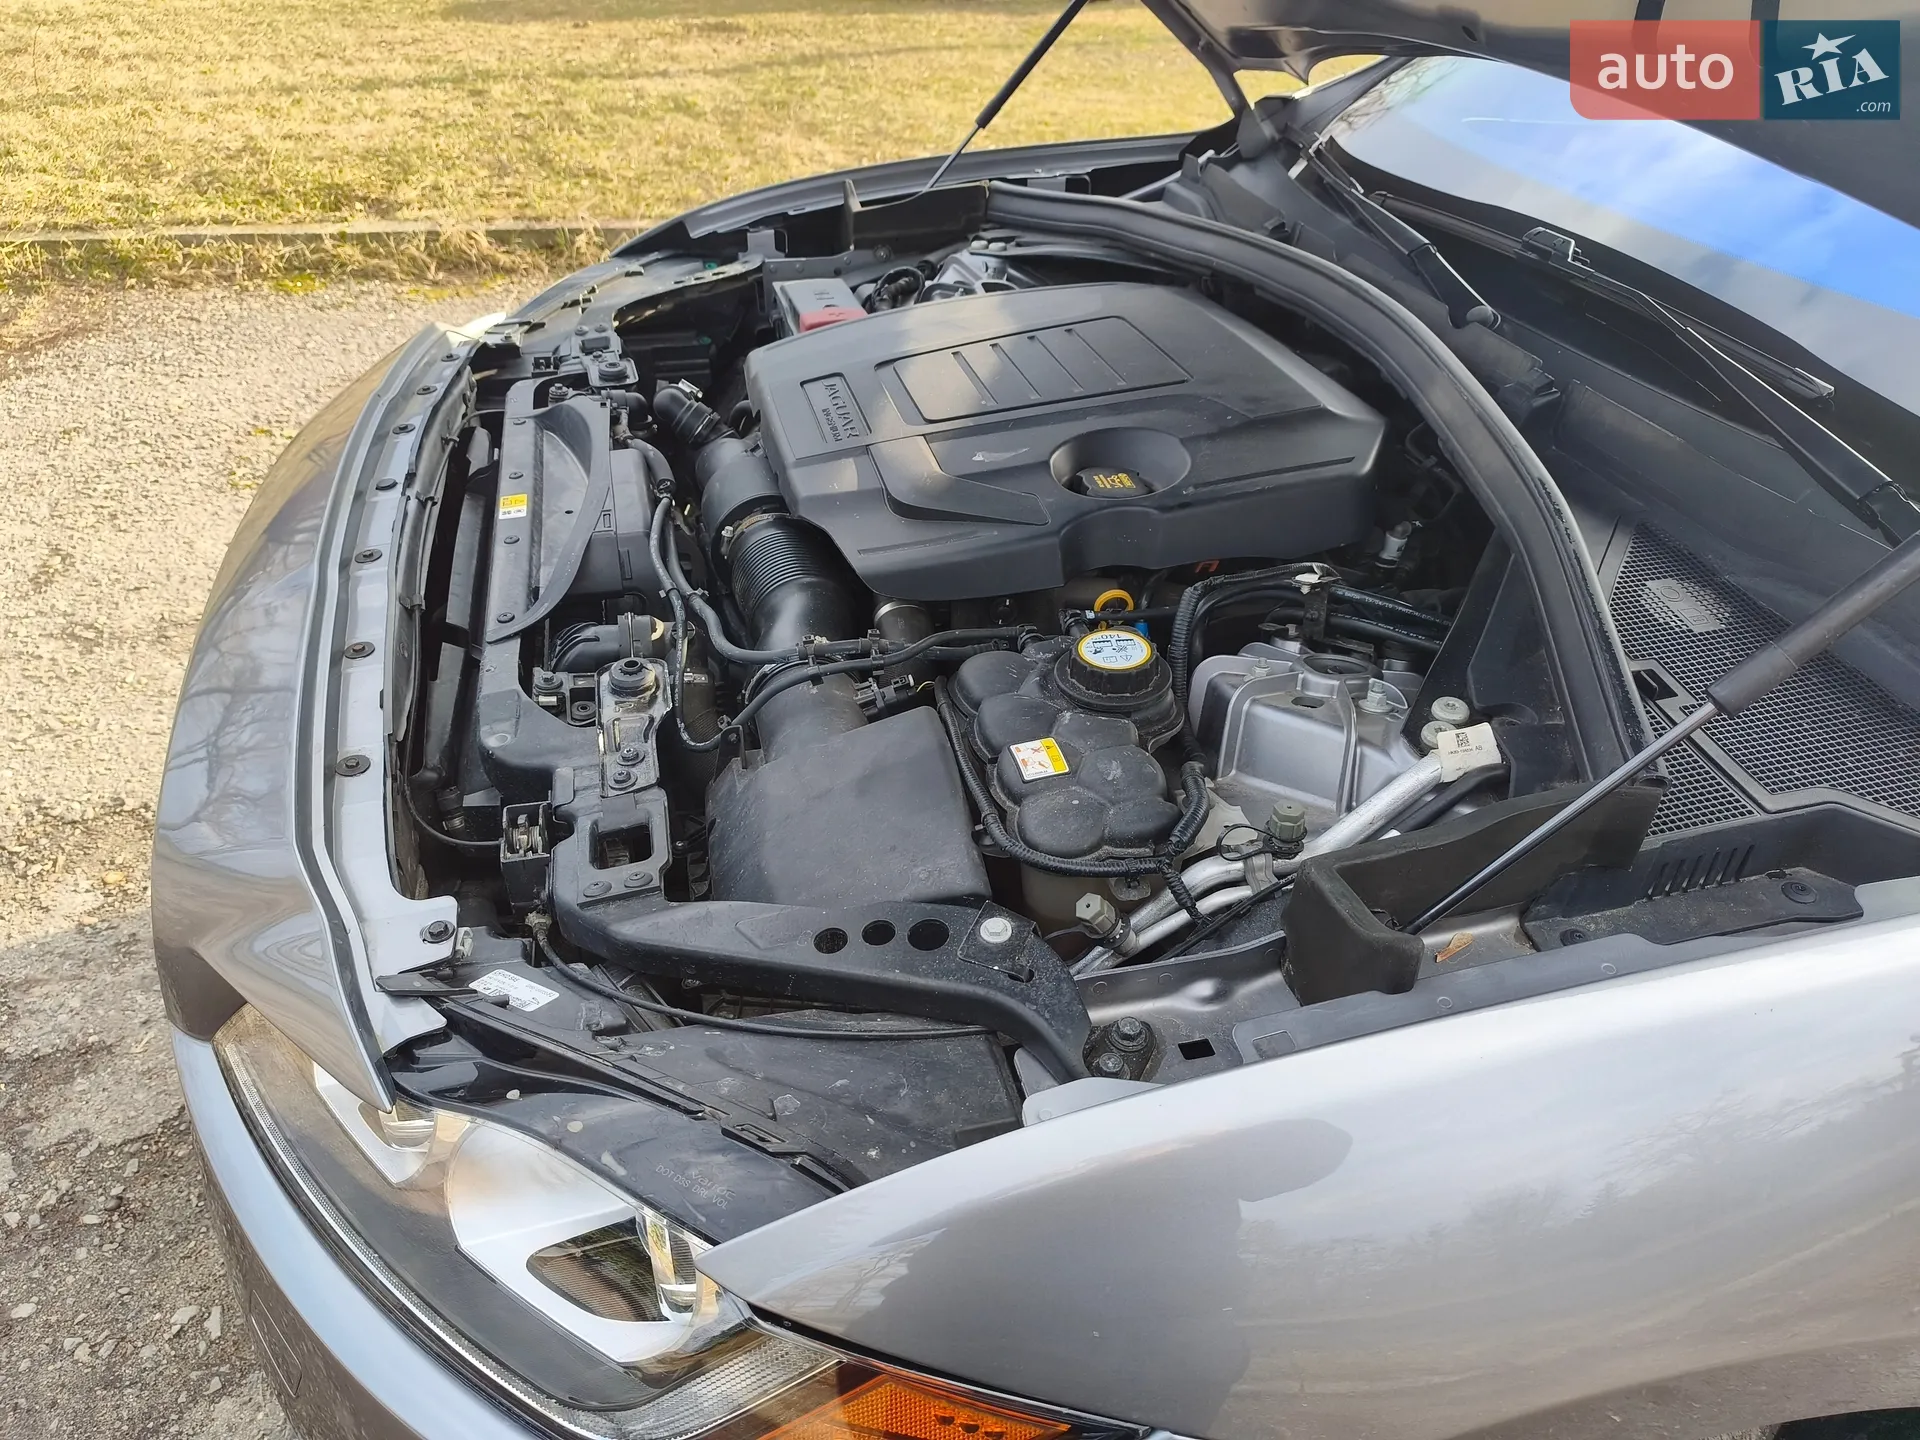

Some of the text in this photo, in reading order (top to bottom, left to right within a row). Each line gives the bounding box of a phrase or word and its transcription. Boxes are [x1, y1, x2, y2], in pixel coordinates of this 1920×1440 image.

[821, 380, 860, 439] JAGUAR
[655, 1164, 728, 1210] DOT D3S DRL VOL
[692, 1171, 737, 1200] varroc
